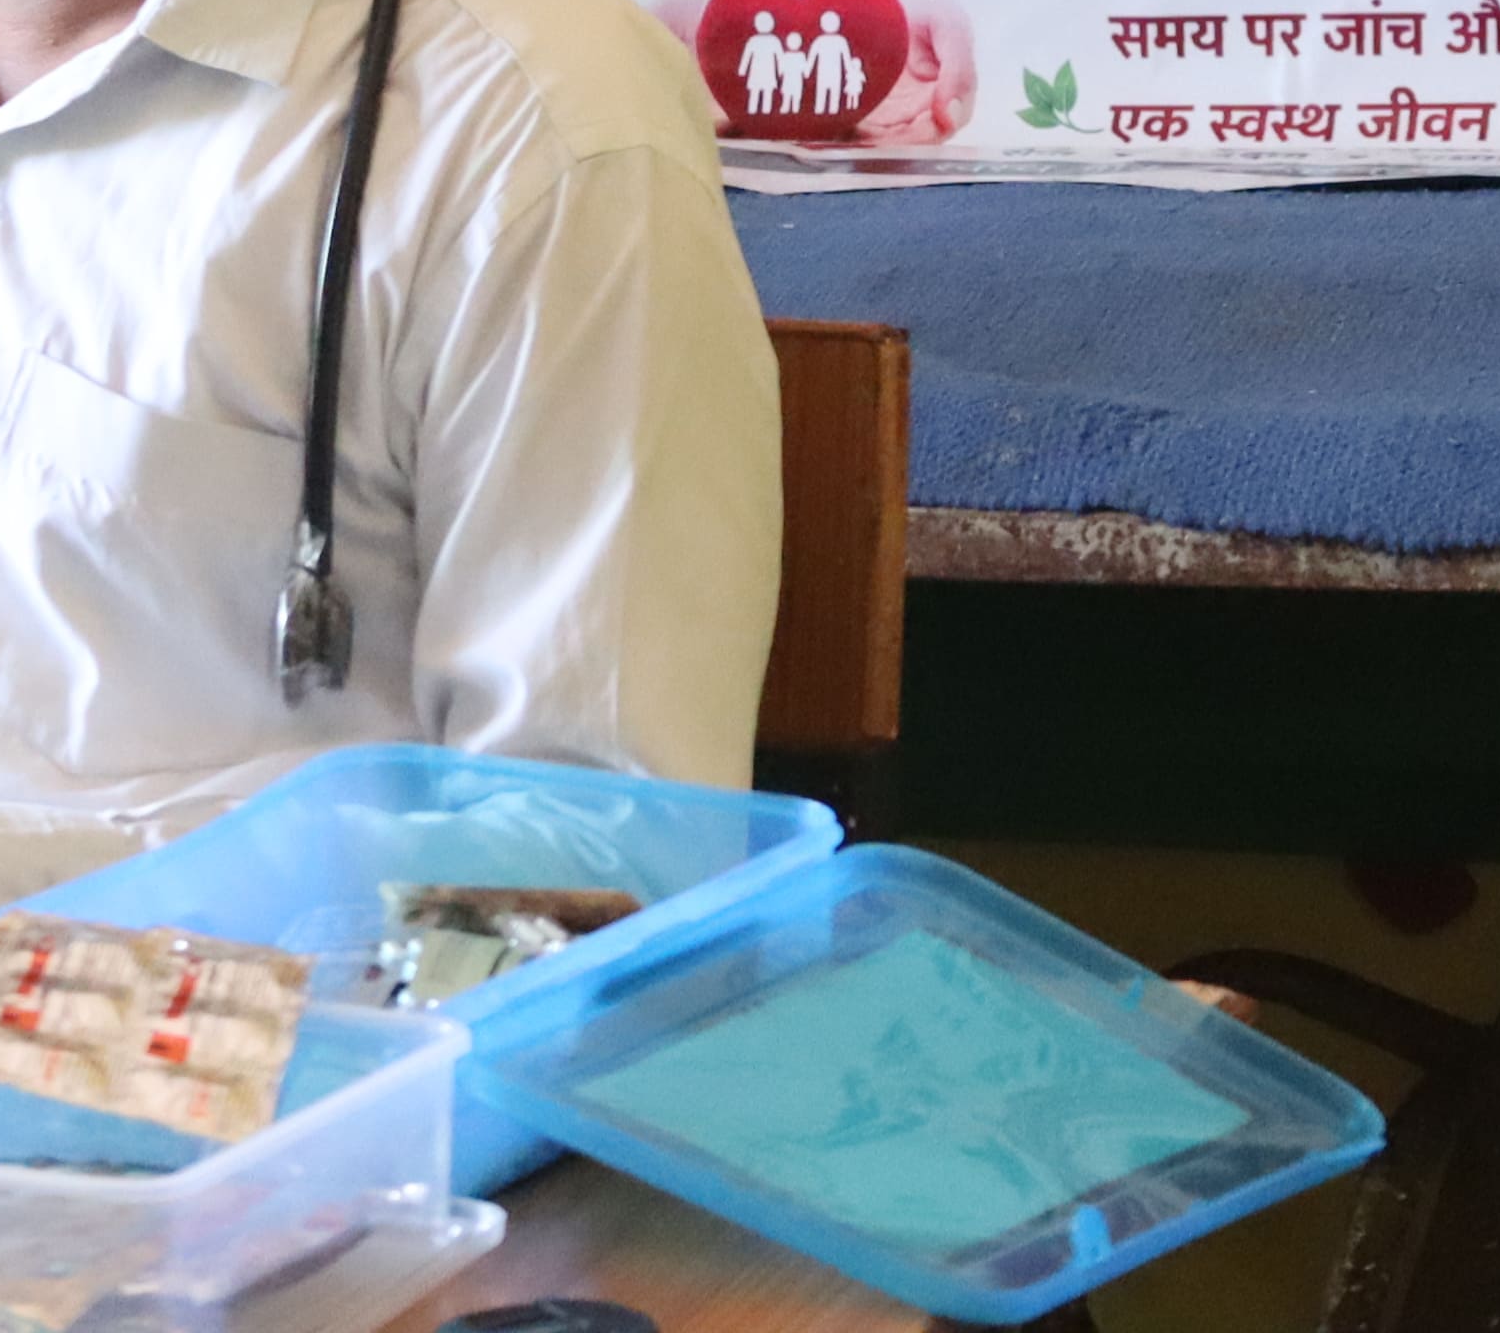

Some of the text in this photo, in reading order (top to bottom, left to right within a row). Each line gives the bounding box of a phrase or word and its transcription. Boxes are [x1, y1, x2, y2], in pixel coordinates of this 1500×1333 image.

[1109, 16, 1227, 58] समय
[1242, 14, 1306, 56] पर
[1109, 102, 1195, 143] एक
[1209, 101, 1341, 144] स्वस्थ
[1357, 86, 1495, 143] जीवन
